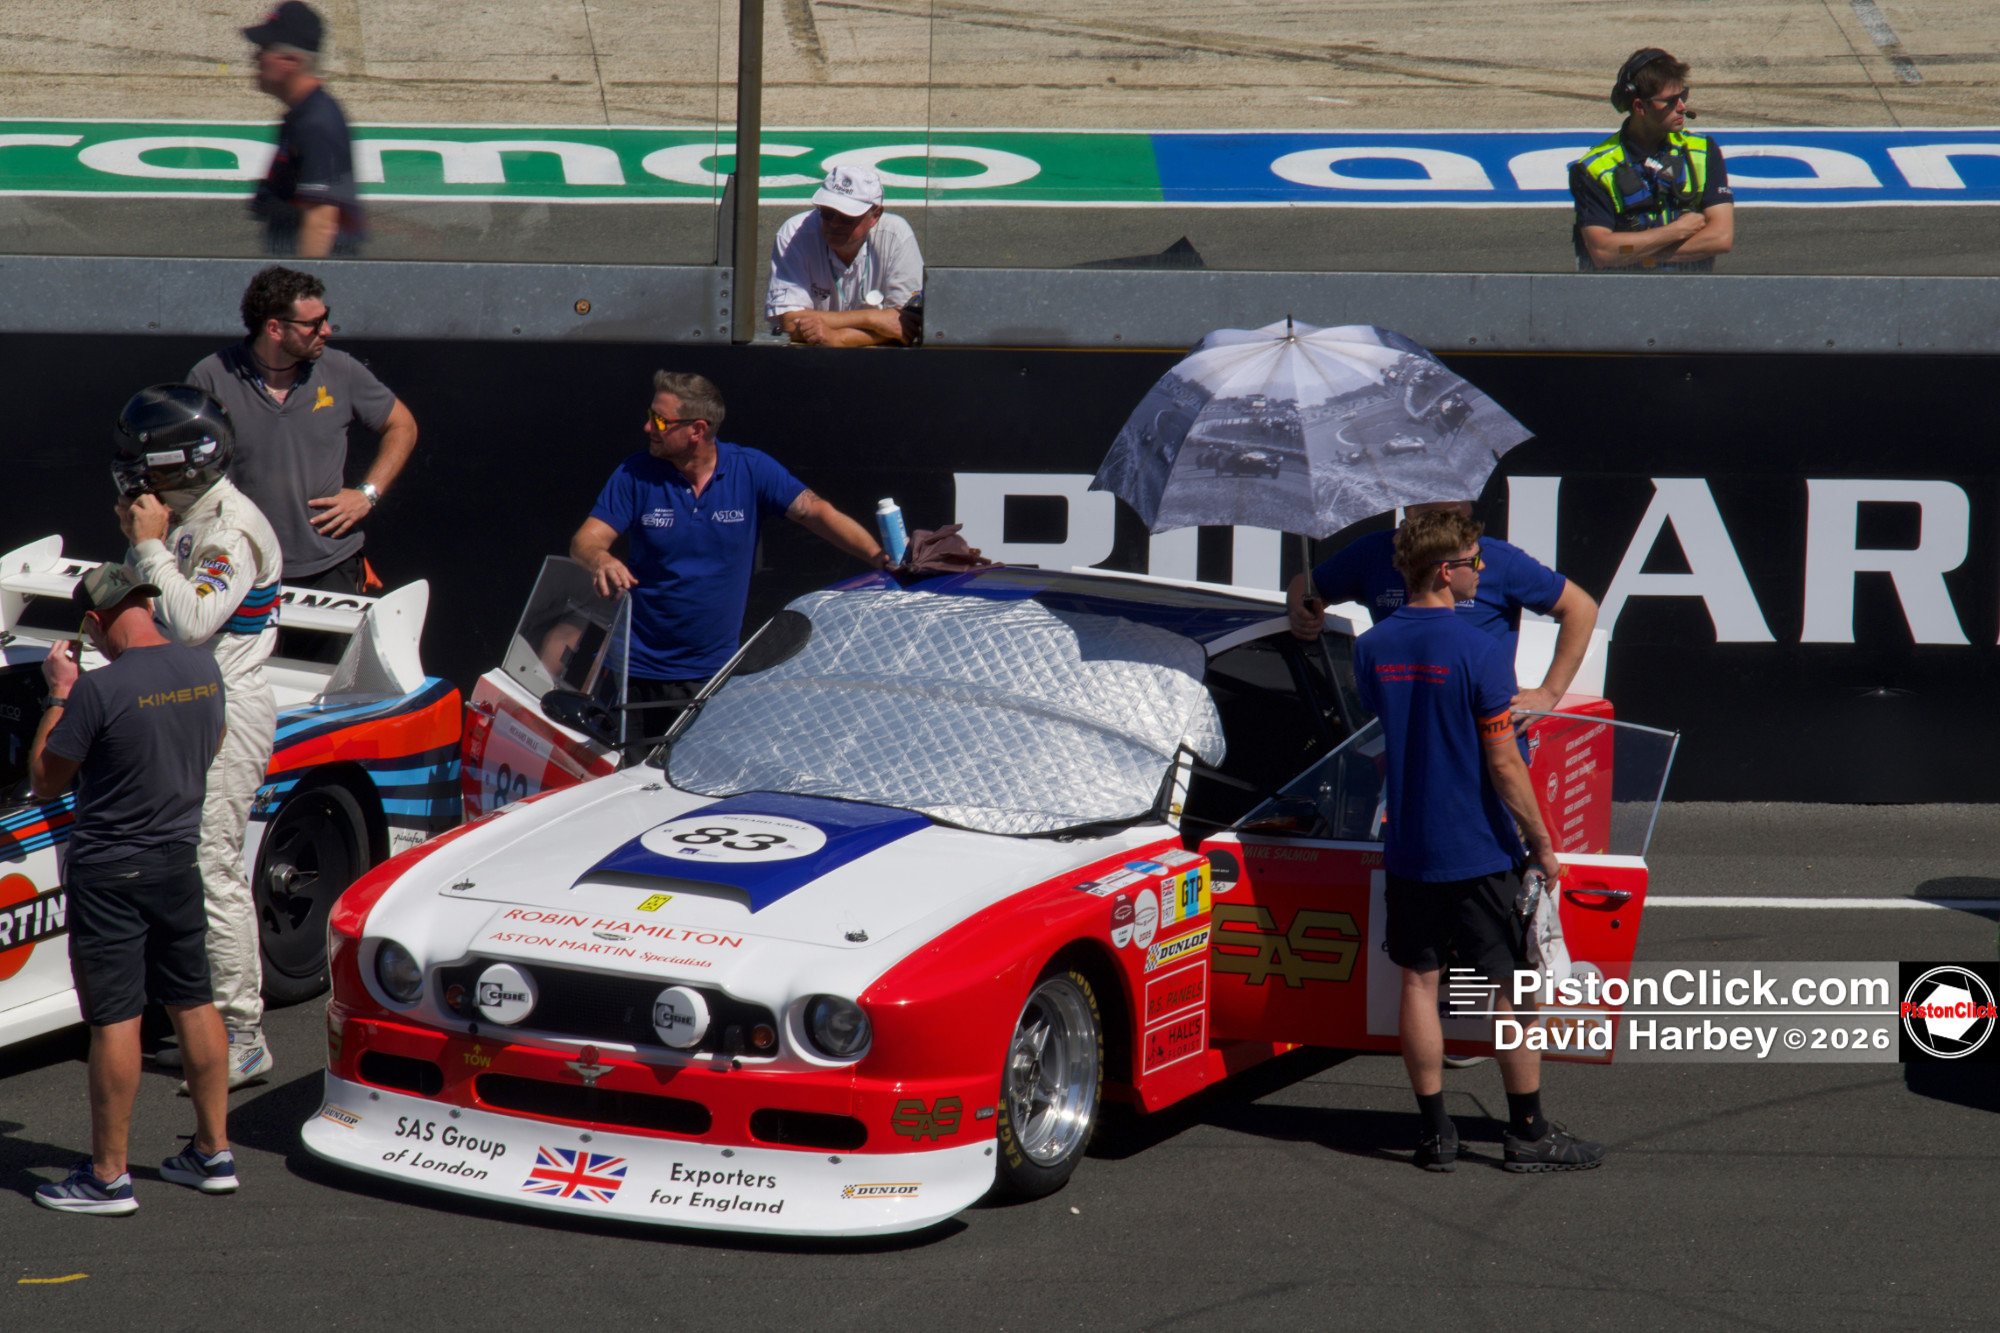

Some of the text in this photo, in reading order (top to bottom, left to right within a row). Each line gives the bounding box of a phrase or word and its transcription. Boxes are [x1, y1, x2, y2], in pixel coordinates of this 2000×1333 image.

[711, 509, 744, 521] ASTON
[672, 827, 788, 852] 83
[1242, 846, 1320, 862] MIKE SALMON
[1182, 874, 1203, 908] GTP
[503, 909, 743, 948] ROBIN HAMILTON
[489, 931, 713, 968] ASTON MARTIN Specialists
[1159, 931, 1208, 960] DUNLOP
[1166, 980, 1203, 1008] PANELS
[1168, 1018, 1201, 1045] HALL'S
[463, 1053, 492, 1067] TOW
[1168, 1038, 1200, 1059] FLORIST
[324, 1107, 358, 1126] DUNLOP
[395, 1115, 507, 1161] SAS Group
[998, 1099, 1022, 1169] EAGLE
[381, 1149, 489, 1181] of London
[670, 1161, 777, 1189] Exporters
[649, 1188, 784, 1215] for England
[856, 1184, 919, 1196] DUNLOP
